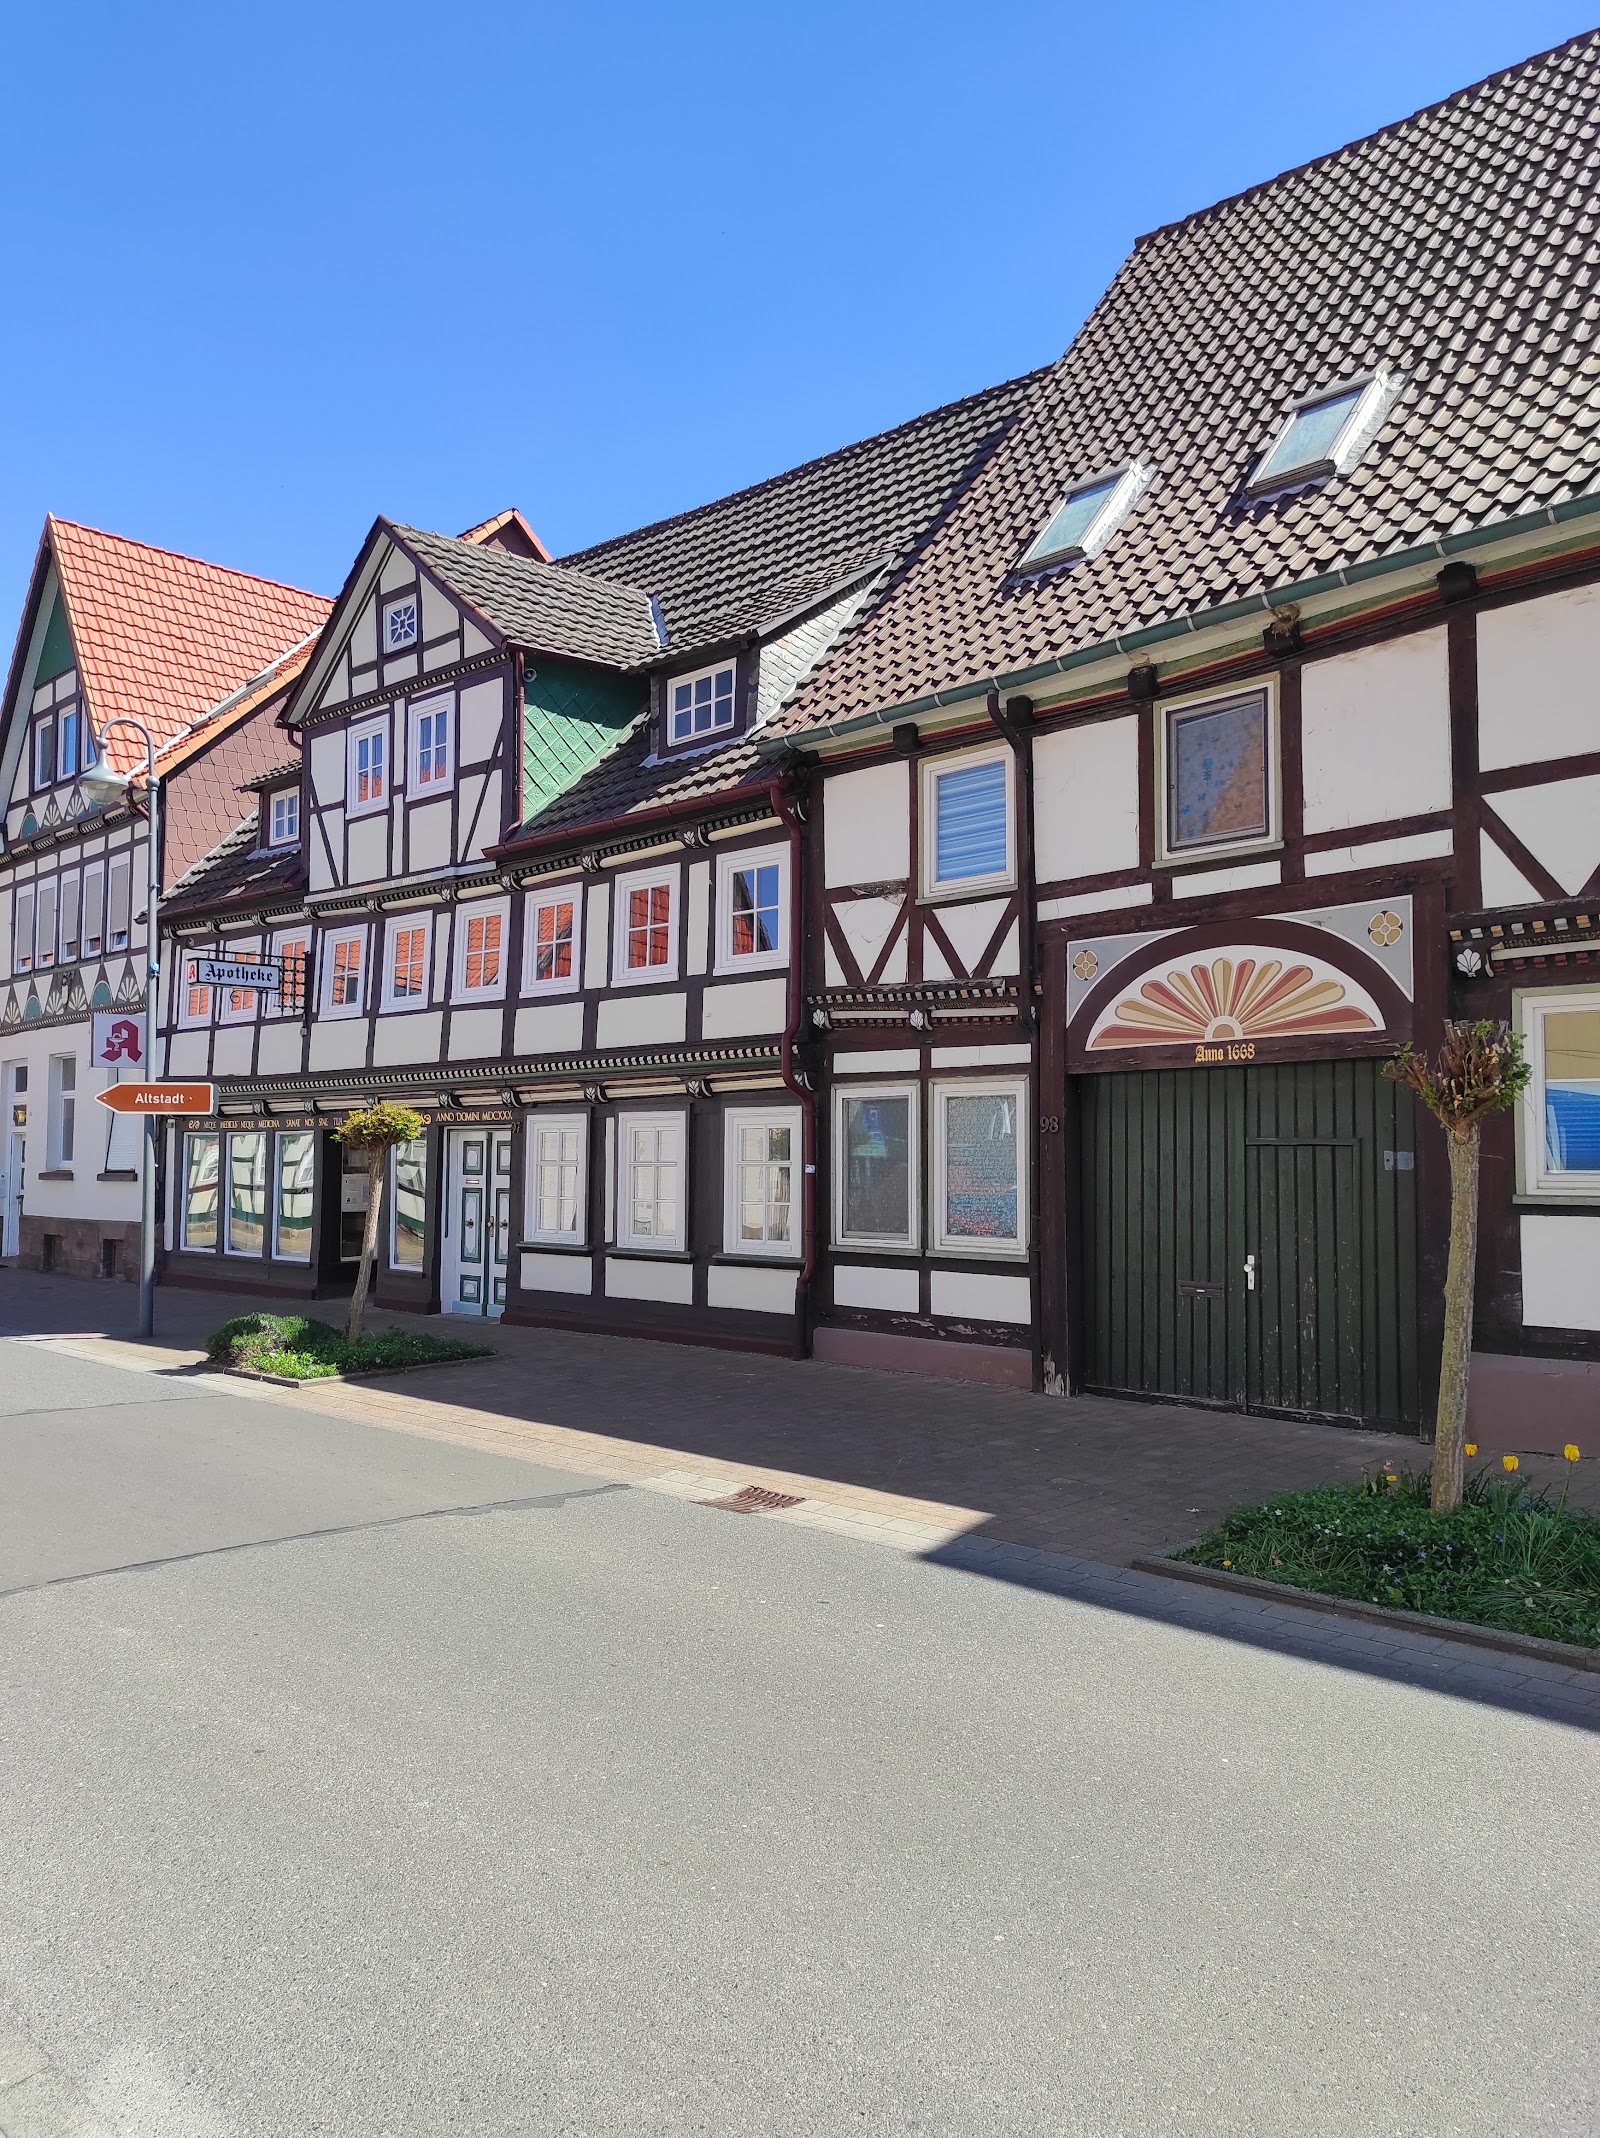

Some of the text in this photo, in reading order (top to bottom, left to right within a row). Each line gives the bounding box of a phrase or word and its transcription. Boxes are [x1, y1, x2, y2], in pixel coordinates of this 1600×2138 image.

[188, 964, 196, 980] A
[205, 963, 273, 983] Apotheke
[100, 1019, 143, 1063] A
[1194, 1043, 1256, 1063] Anno 1668
[135, 1093, 184, 1104] Altstadt
[436, 1110, 513, 1121] ANNO DOMINI MDCXXX
[240, 1120, 255, 1130] NEQUE
[304, 1118, 315, 1126] NOS
[511, 1122, 521, 1134] 97
[1040, 1116, 1059, 1133] 98
